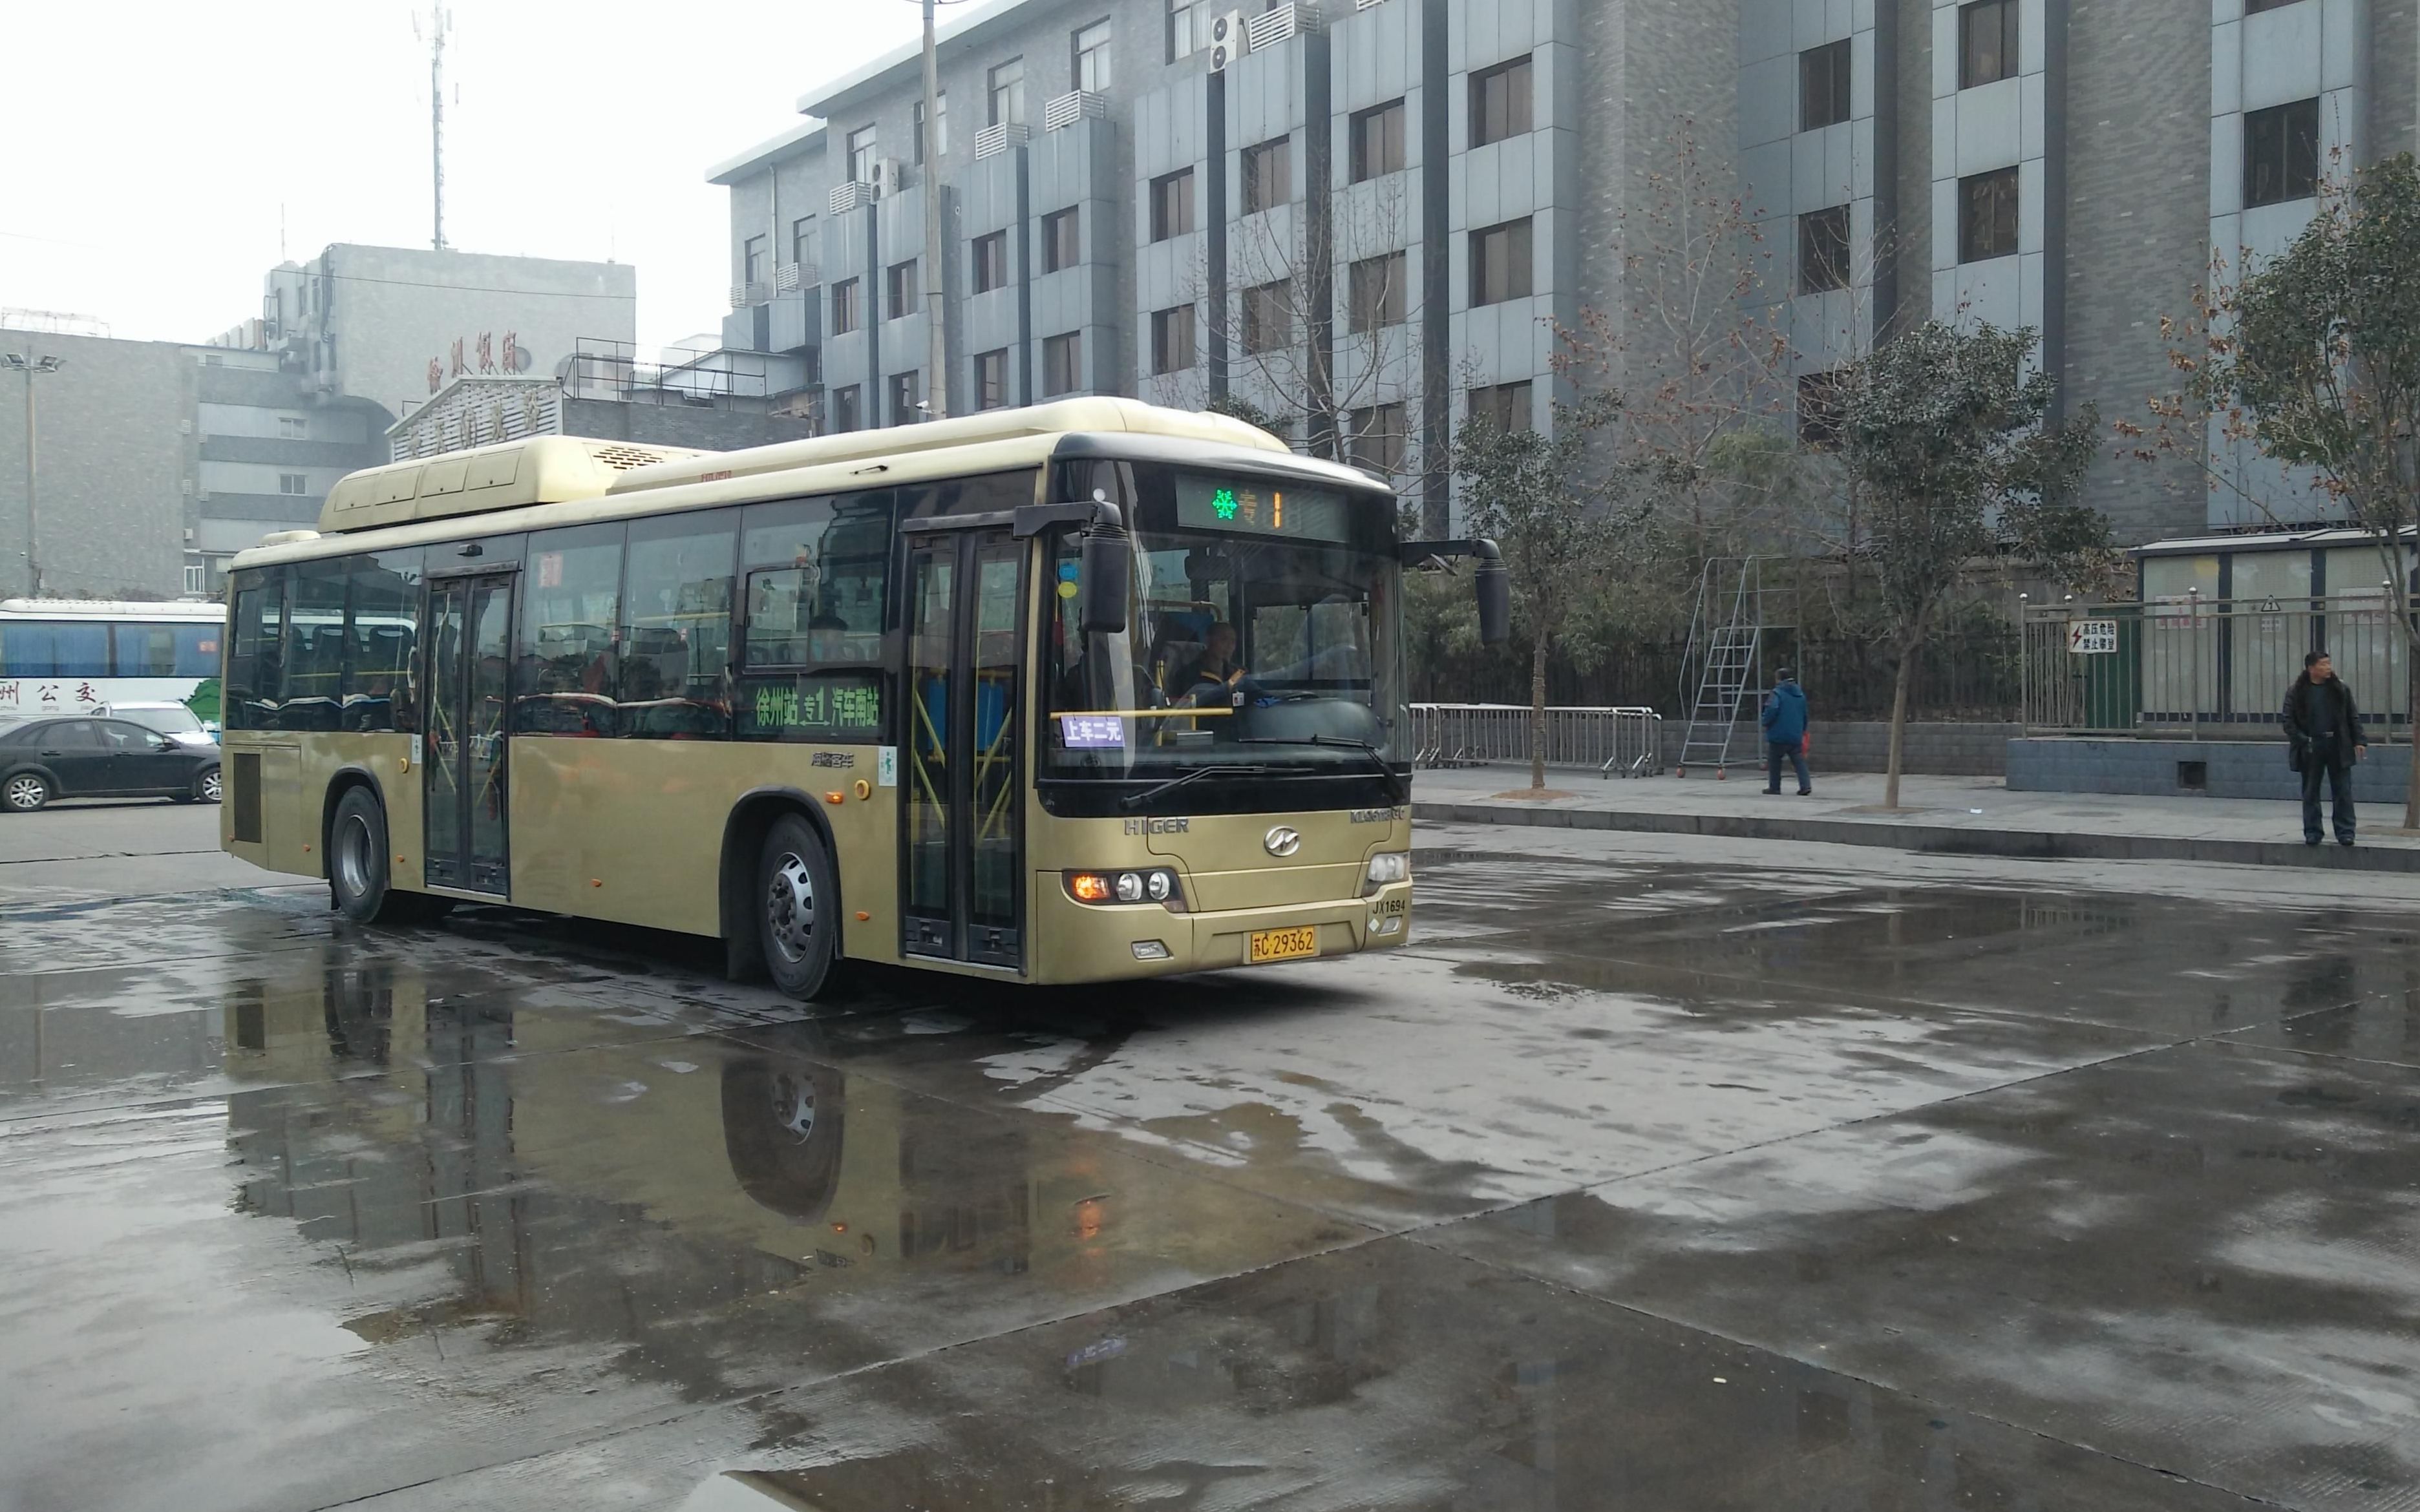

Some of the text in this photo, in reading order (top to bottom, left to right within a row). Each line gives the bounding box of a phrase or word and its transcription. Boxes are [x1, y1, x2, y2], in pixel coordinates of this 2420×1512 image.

[756, 687, 798, 726] 徐州站
[831, 686, 878, 727] 汽车南站
[1067, 720, 1121, 741] 上车二元
[1125, 818, 1189, 835] HIGER
[1373, 900, 1405, 914] JX1694
